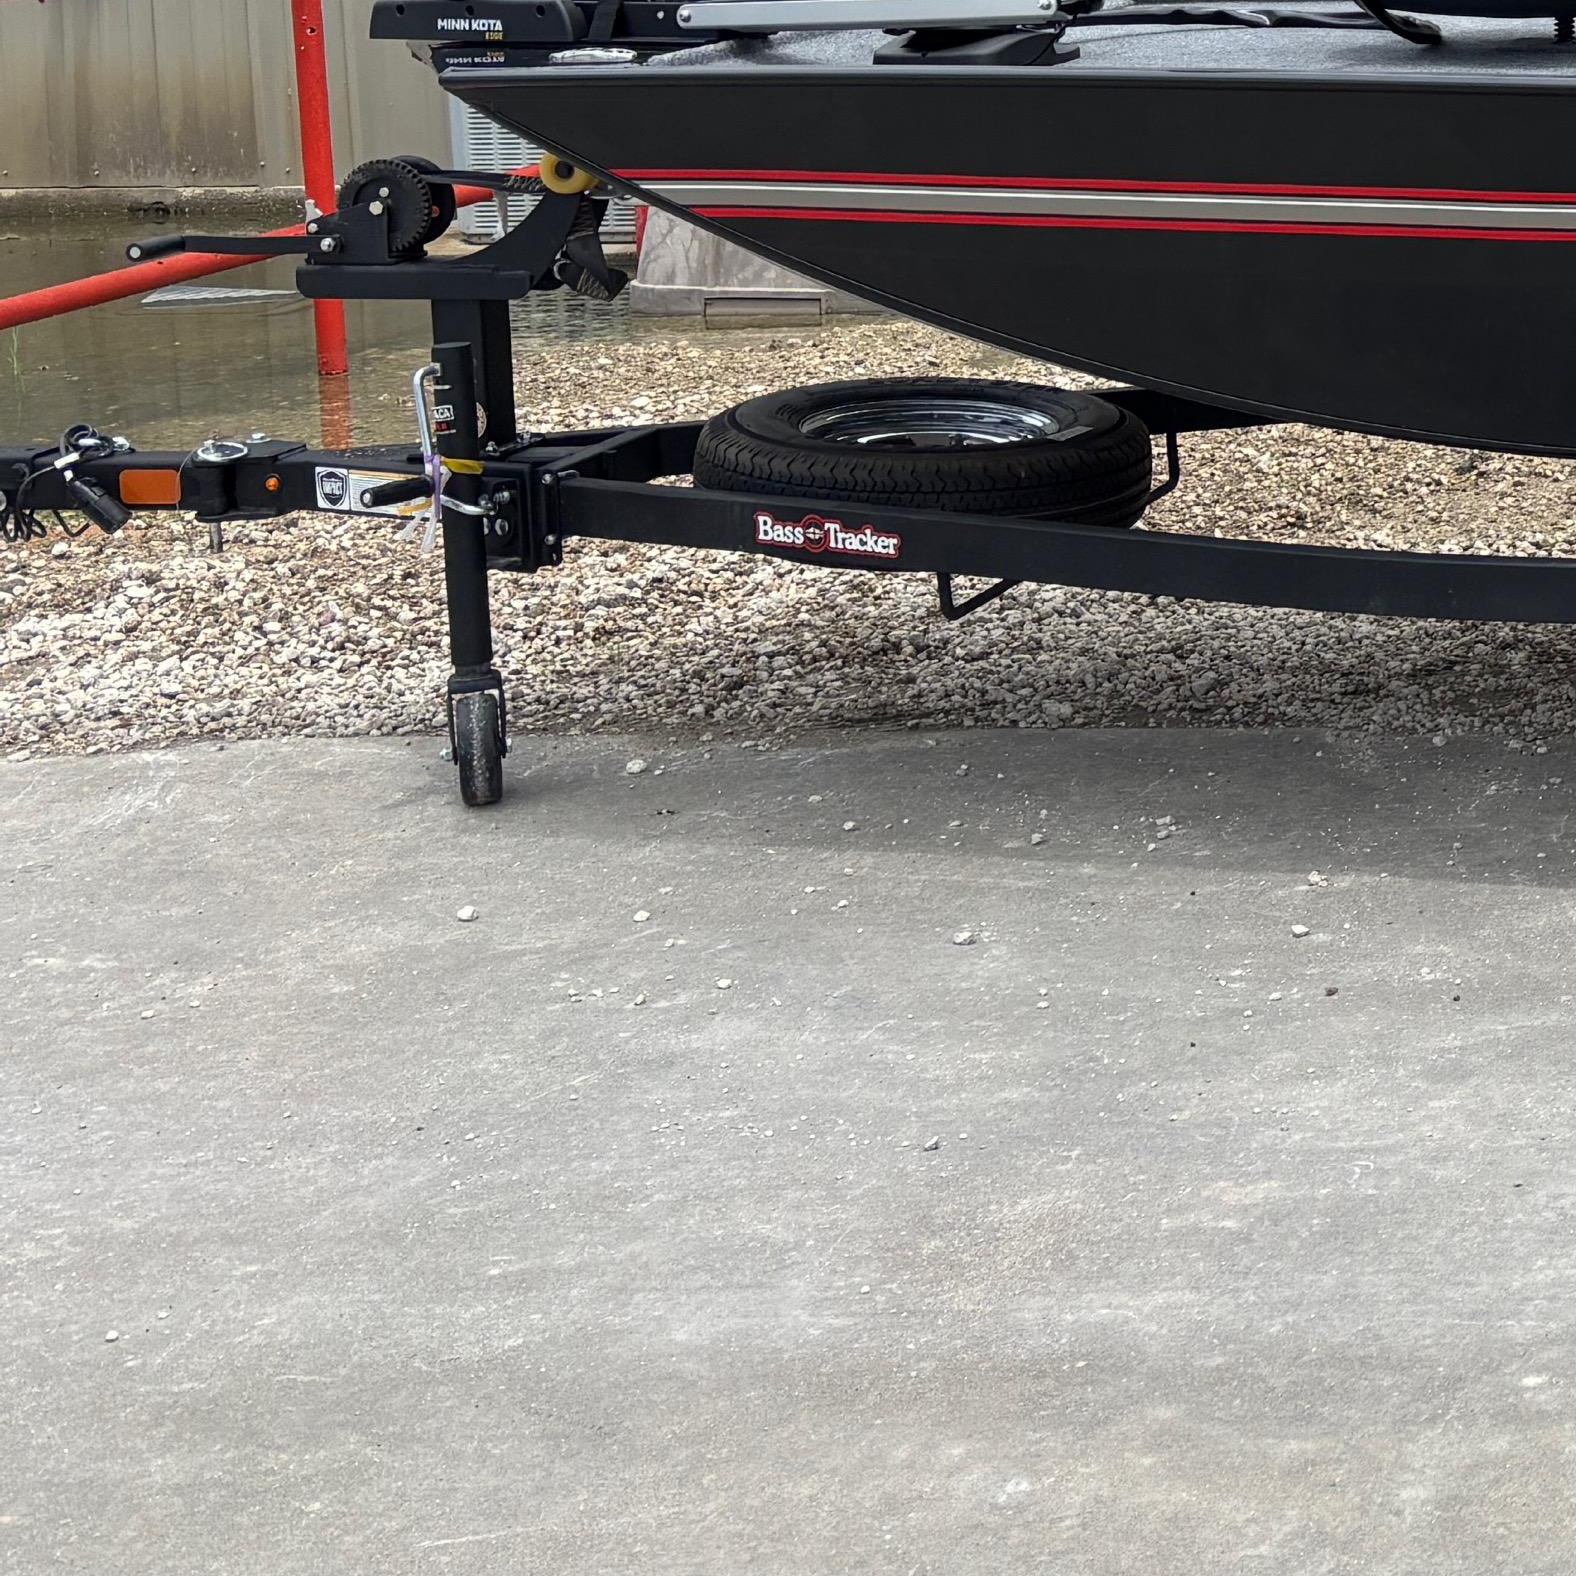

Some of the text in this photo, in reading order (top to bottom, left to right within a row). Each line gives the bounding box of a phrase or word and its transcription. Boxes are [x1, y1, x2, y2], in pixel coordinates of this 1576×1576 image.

[437, 18, 504, 31] MINN KOTA
[757, 515, 898, 555] Bass Tracker
